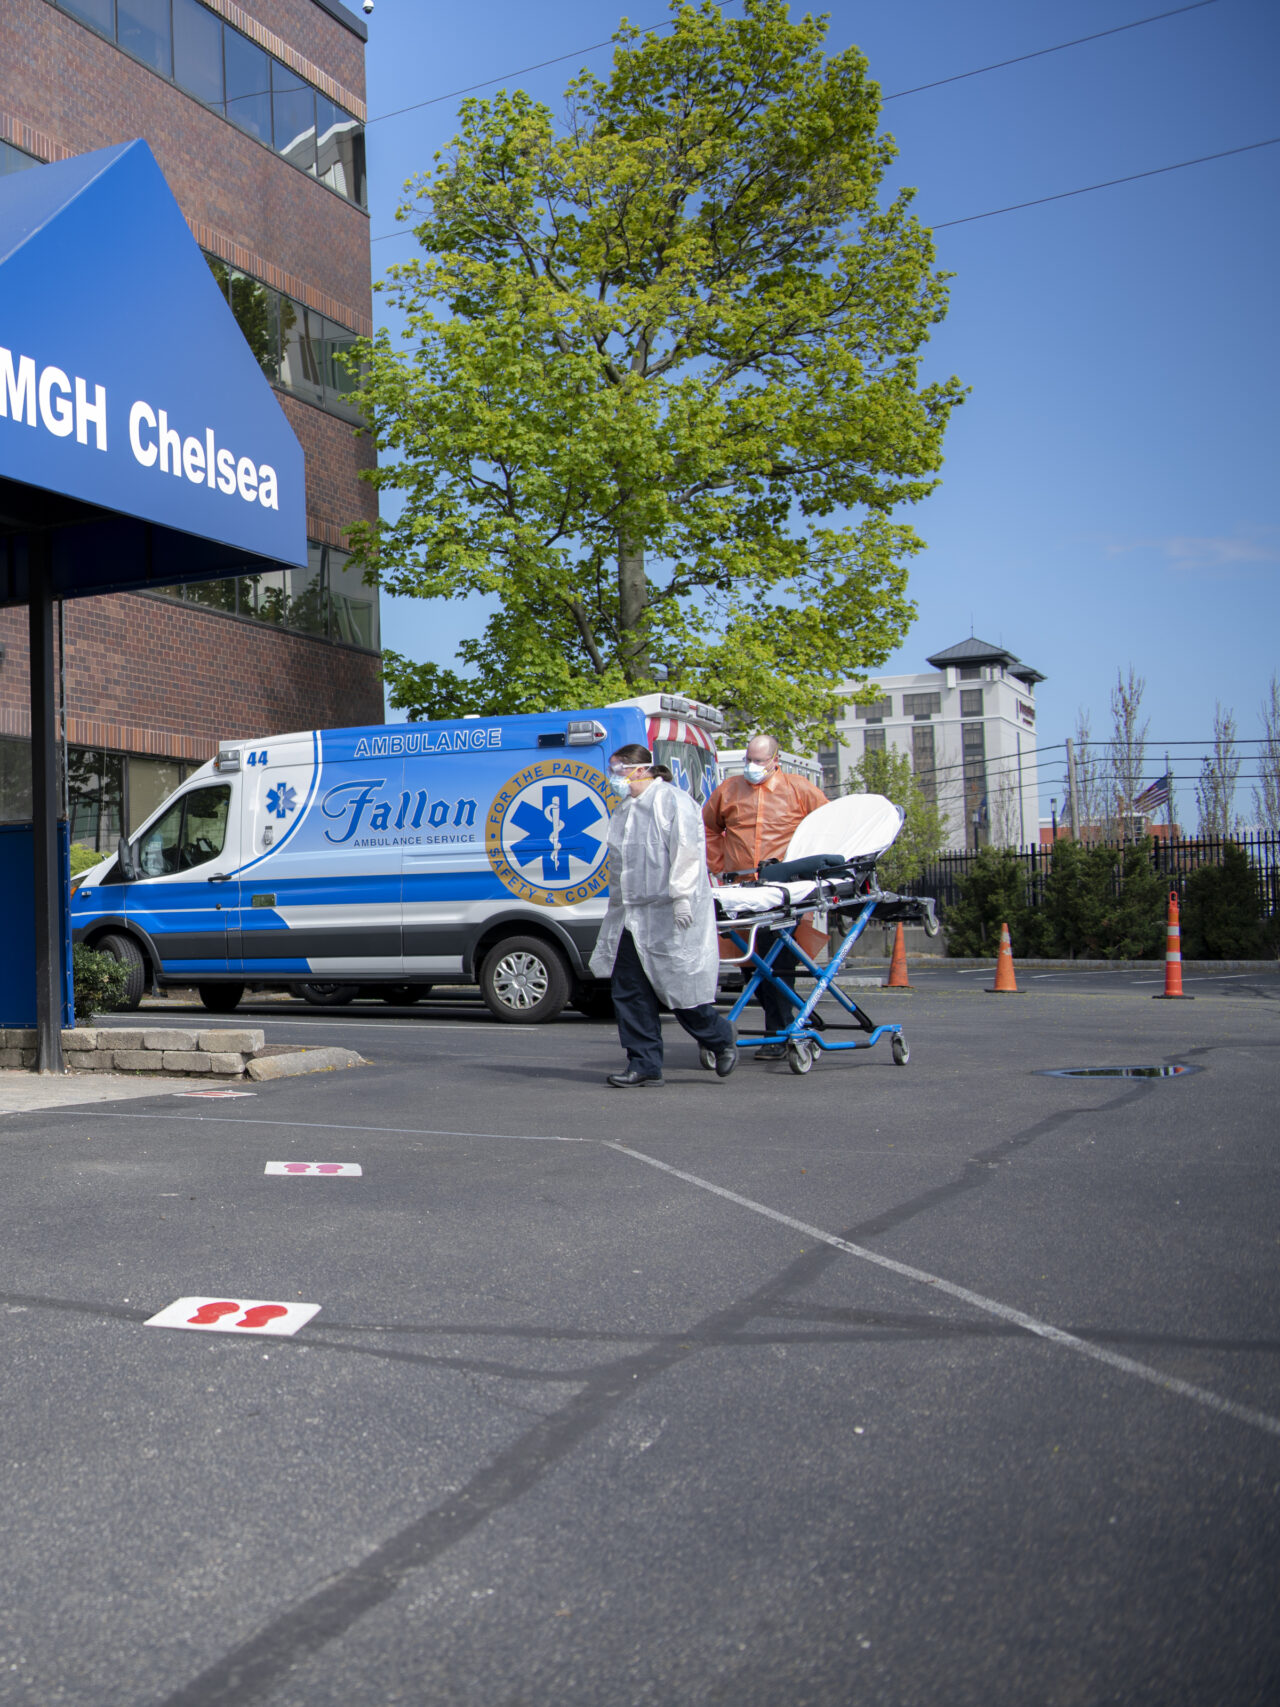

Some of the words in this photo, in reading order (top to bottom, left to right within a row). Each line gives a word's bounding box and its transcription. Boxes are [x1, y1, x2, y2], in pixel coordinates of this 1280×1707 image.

[128, 400, 279, 511] Chelsea
[246, 750, 269, 767] 44
[353, 728, 502, 758] AMBULANCE
[321, 778, 479, 844] Fallon
[490, 791, 512, 824] FOR
[512, 766, 544, 789] THE
[353, 836, 422, 848] AMBULANCE
[426, 834, 477, 845] SERVICE
[489, 847, 537, 899] SAFETY
[545, 893, 555, 903] &
